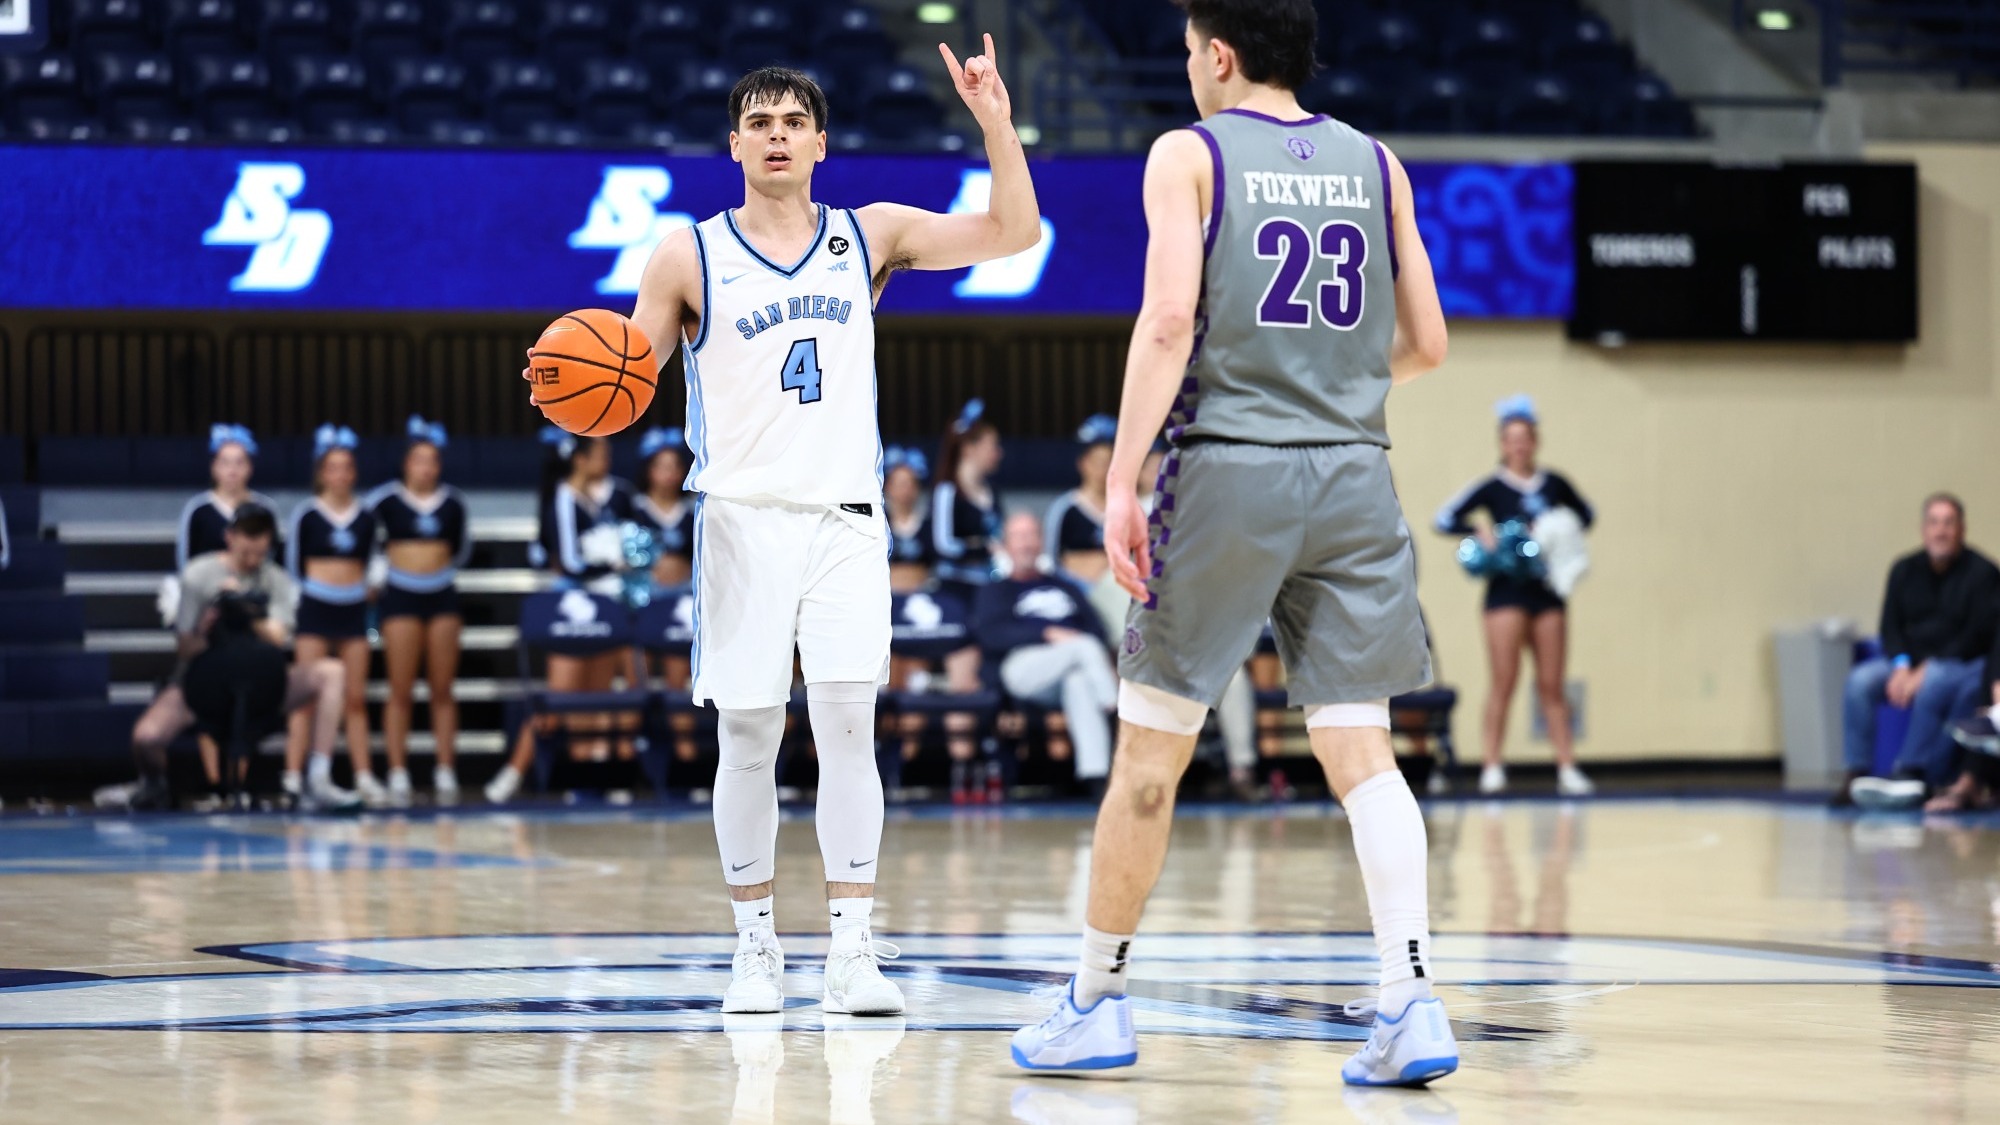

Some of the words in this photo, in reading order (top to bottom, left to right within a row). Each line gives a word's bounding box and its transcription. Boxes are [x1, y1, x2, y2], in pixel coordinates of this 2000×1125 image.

[1243, 171, 1371, 209] FOXWELL
[203, 162, 332, 291] SD
[832, 240, 848, 253] JC
[1253, 216, 1369, 331] 23
[735, 302, 784, 340] SAN
[788, 295, 852, 325] DIEGO
[780, 337, 822, 404] 4
